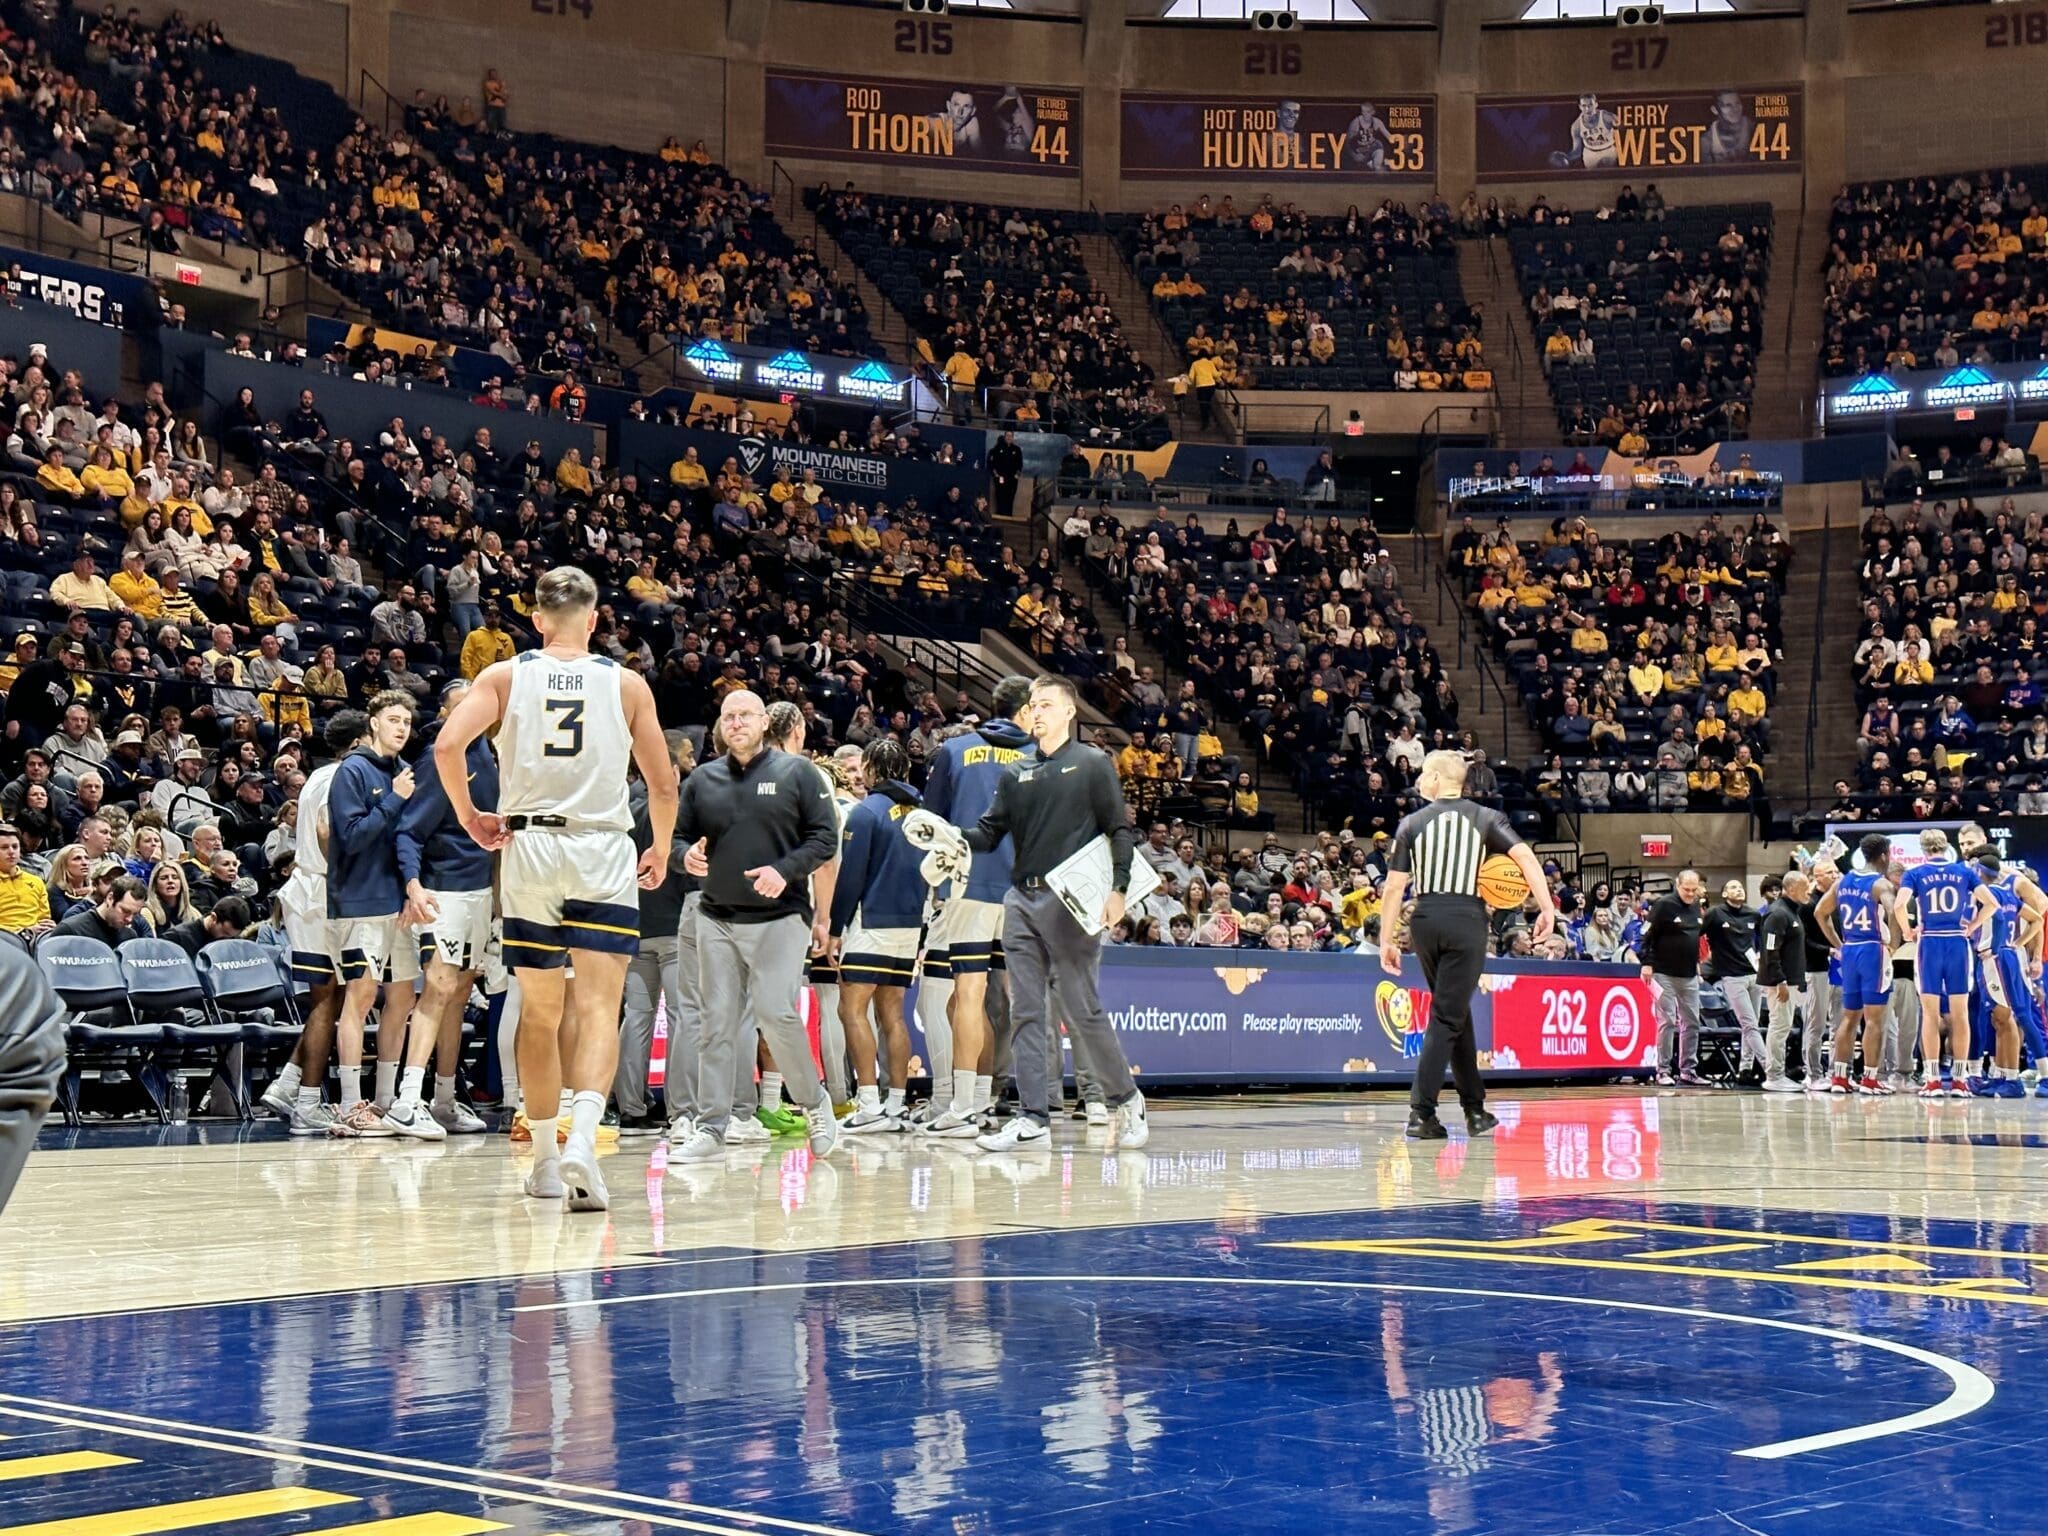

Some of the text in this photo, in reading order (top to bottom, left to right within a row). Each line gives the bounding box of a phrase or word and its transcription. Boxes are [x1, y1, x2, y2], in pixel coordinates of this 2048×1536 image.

[894, 19, 953, 55] 215
[1985, 12, 2048, 48] 218
[1244, 43, 1301, 75] 216
[1611, 36, 1670, 70] 217
[847, 87, 881, 110] ROD
[1037, 97, 1067, 109] RETIRED
[1755, 95, 1788, 106] RETIRED
[1036, 109, 1069, 121] NUMBER
[1204, 109, 1277, 131] HOT ROD
[1389, 106, 1420, 118] RETIRED
[1614, 104, 1670, 126] JERRY
[1755, 105, 1789, 118] NUMBER
[847, 111, 954, 156] THORN
[1389, 117, 1421, 129] NUMBER
[1031, 125, 1070, 164] 44
[1203, 131, 1347, 170] HUNDLEY
[1388, 133, 1425, 170] 33
[1613, 125, 1706, 167] WEST
[1750, 122, 1790, 161] 44
[839, 375, 869, 391] HIGH
[1927, 383, 2005, 400] HIGH POINT
[2023, 379, 2048, 393] HIG
[1834, 390, 1910, 408] HIGH POINT
[772, 446, 887, 475] MOUNTAINEER
[772, 461, 887, 487] ATHETIC CLUB
[548, 673, 584, 690] KERR
[543, 698, 585, 757] 3
[254, 757, 261, 769] 5
[964, 747, 991, 767] WEST
[757, 782, 778, 795] WVU
[1647, 842, 1667, 856] EXIT
[1495, 884, 1528, 898] Wilson
[1926, 886, 1959, 914] 10
[1840, 903, 1872, 930] 24
[2005, 920, 2016, 947] 3
[1541, 989, 1588, 1035] 262
[1243, 1013, 1277, 1031] Please
[1279, 1013, 1302, 1034] play
[1304, 1013, 1363, 1035] responsibly.
[1541, 1037, 1587, 1056] MILLION
